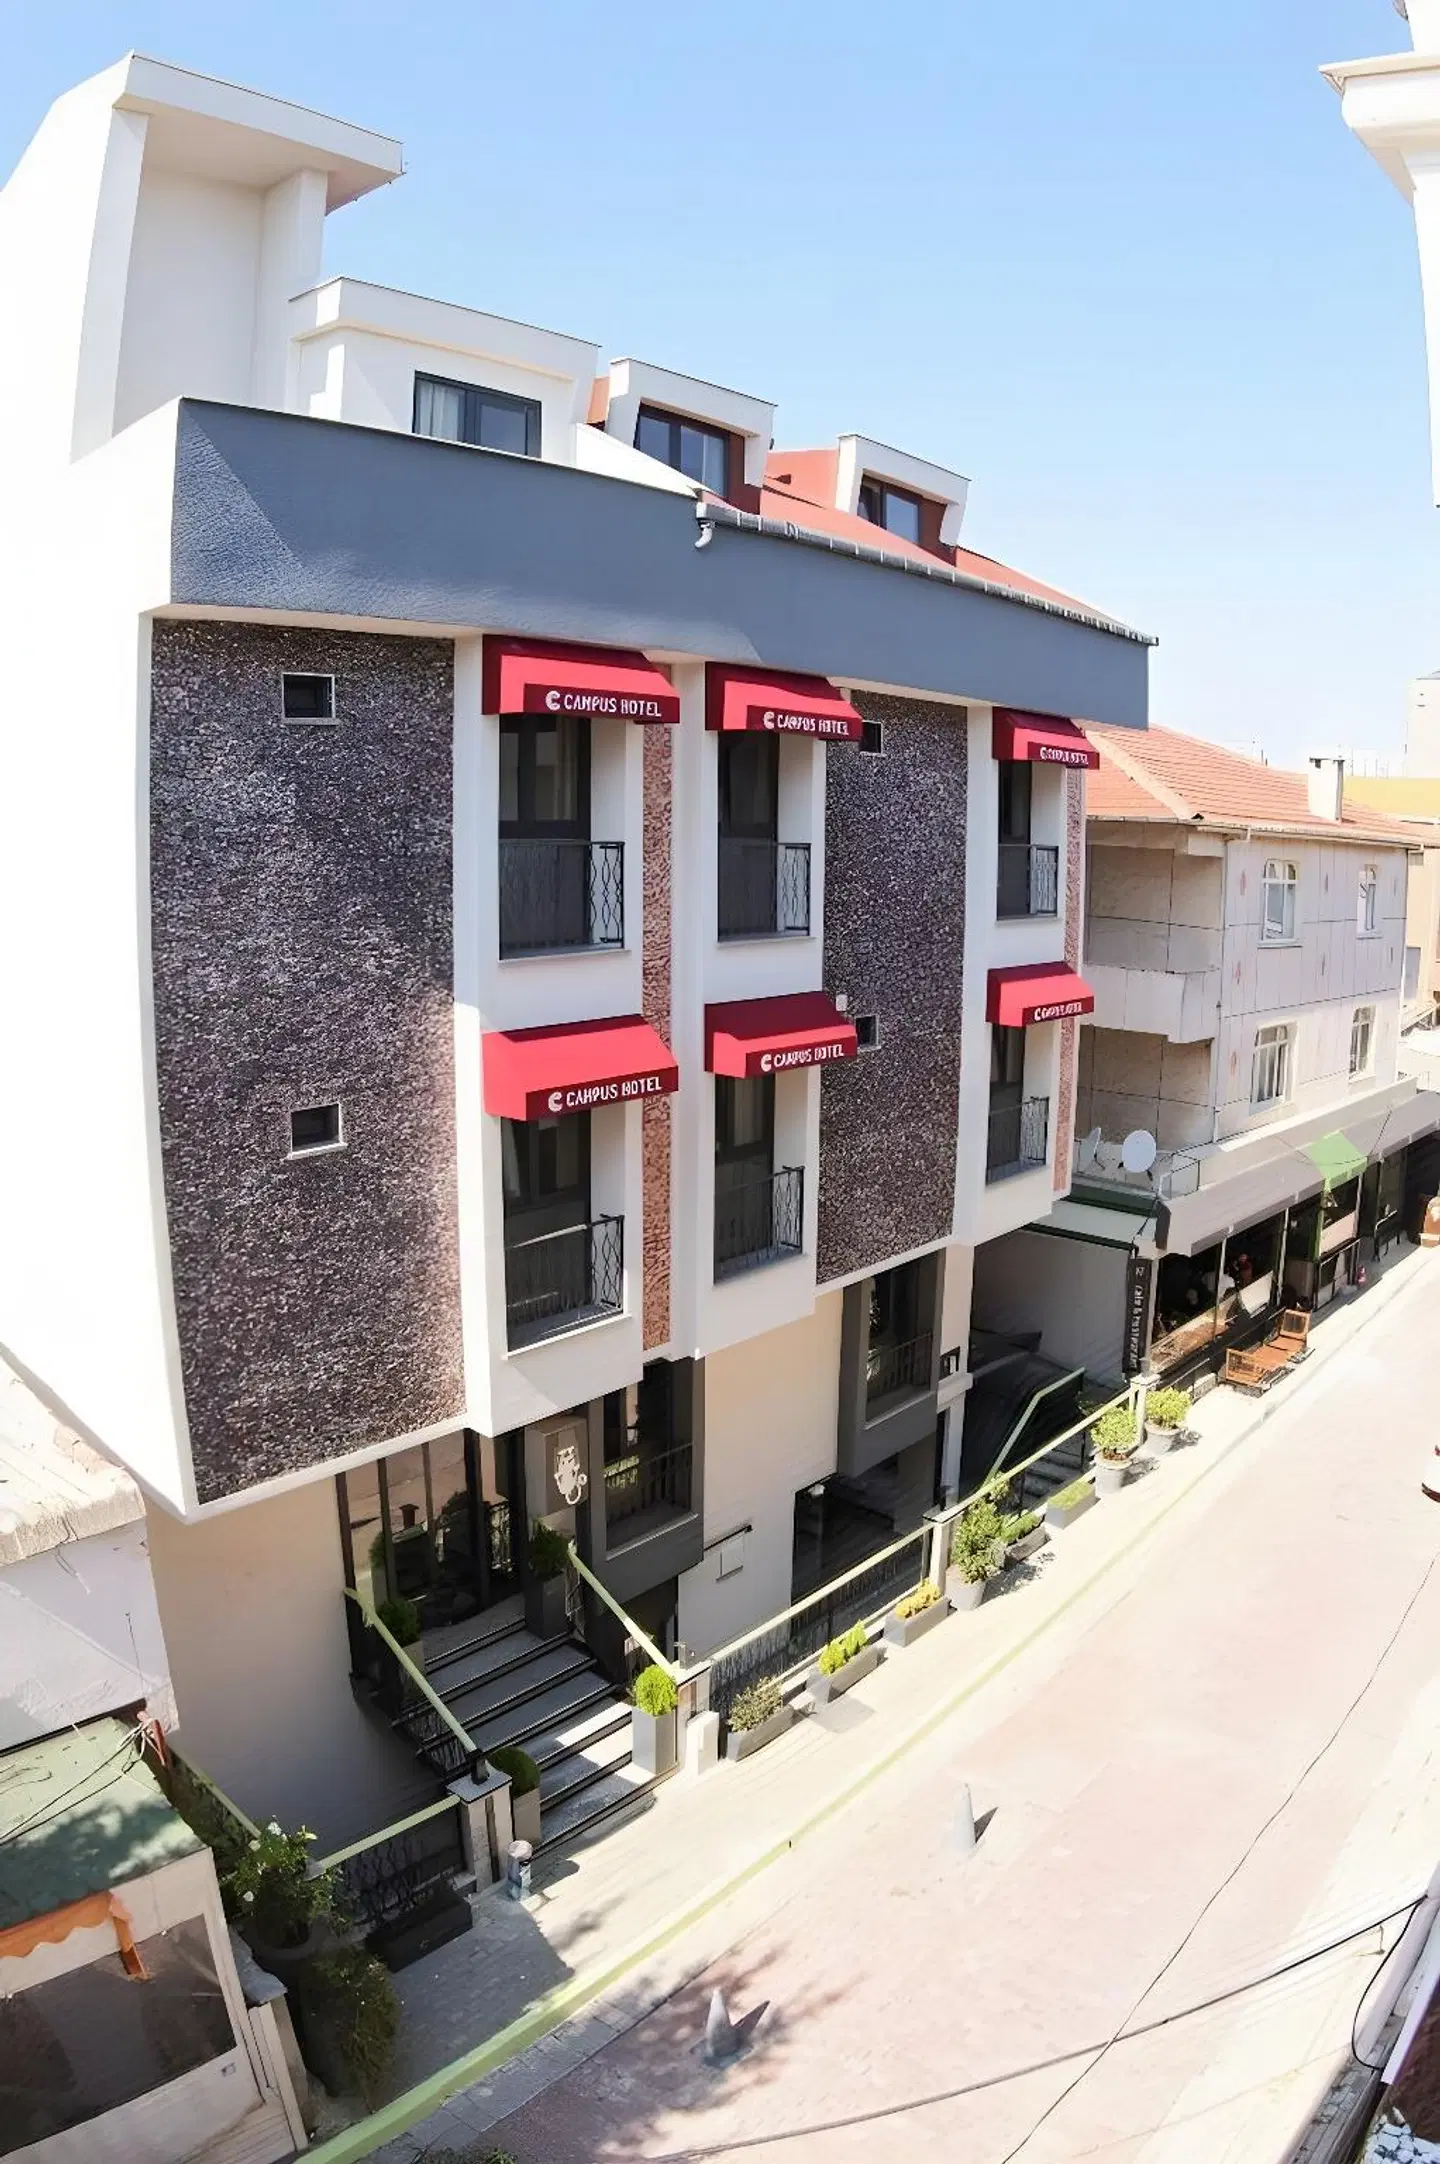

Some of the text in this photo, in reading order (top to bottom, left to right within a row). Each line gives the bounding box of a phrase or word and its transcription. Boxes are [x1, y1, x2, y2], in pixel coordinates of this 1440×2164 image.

[564, 694, 617, 712] CAMPUS
[620, 698, 662, 717] HOTEL
[566, 1084, 618, 1107] CAMPUS
[621, 1076, 662, 1096] HOTEL
